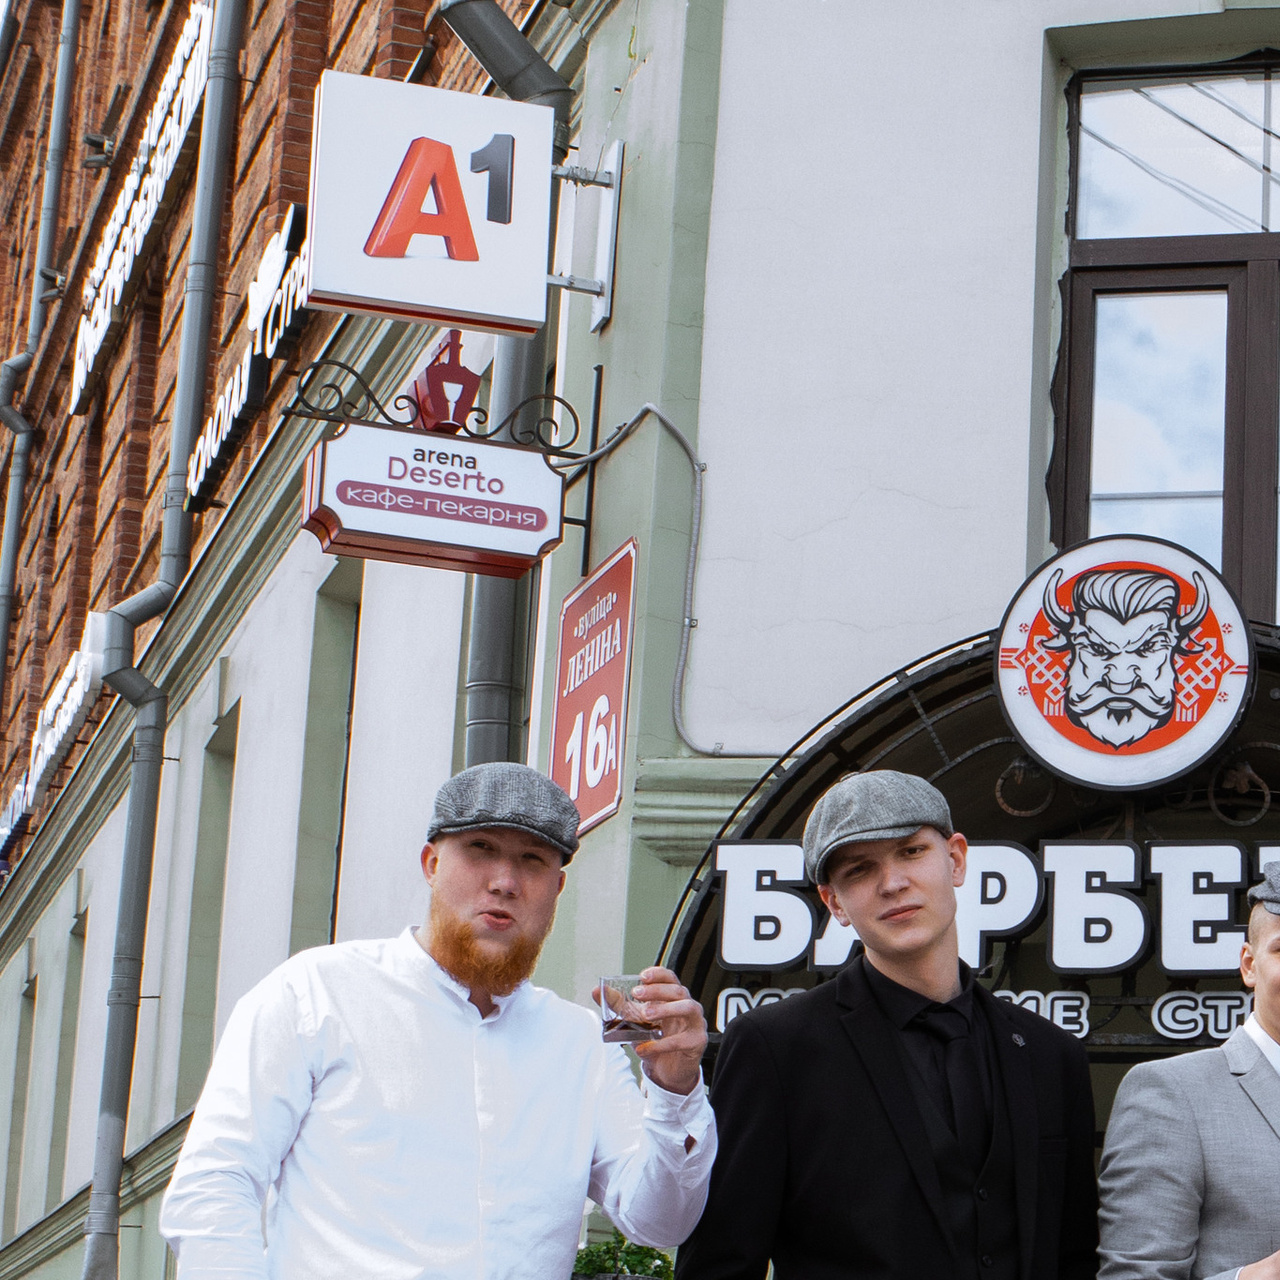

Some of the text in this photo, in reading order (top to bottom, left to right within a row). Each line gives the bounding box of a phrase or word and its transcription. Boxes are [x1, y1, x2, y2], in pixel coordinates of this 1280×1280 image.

[387, 456, 505, 495] Deserto
[412, 448, 478, 469] arena
[346, 486, 537, 526] кафе-пекарня
[563, 618, 622, 697] ЛЕНІНА
